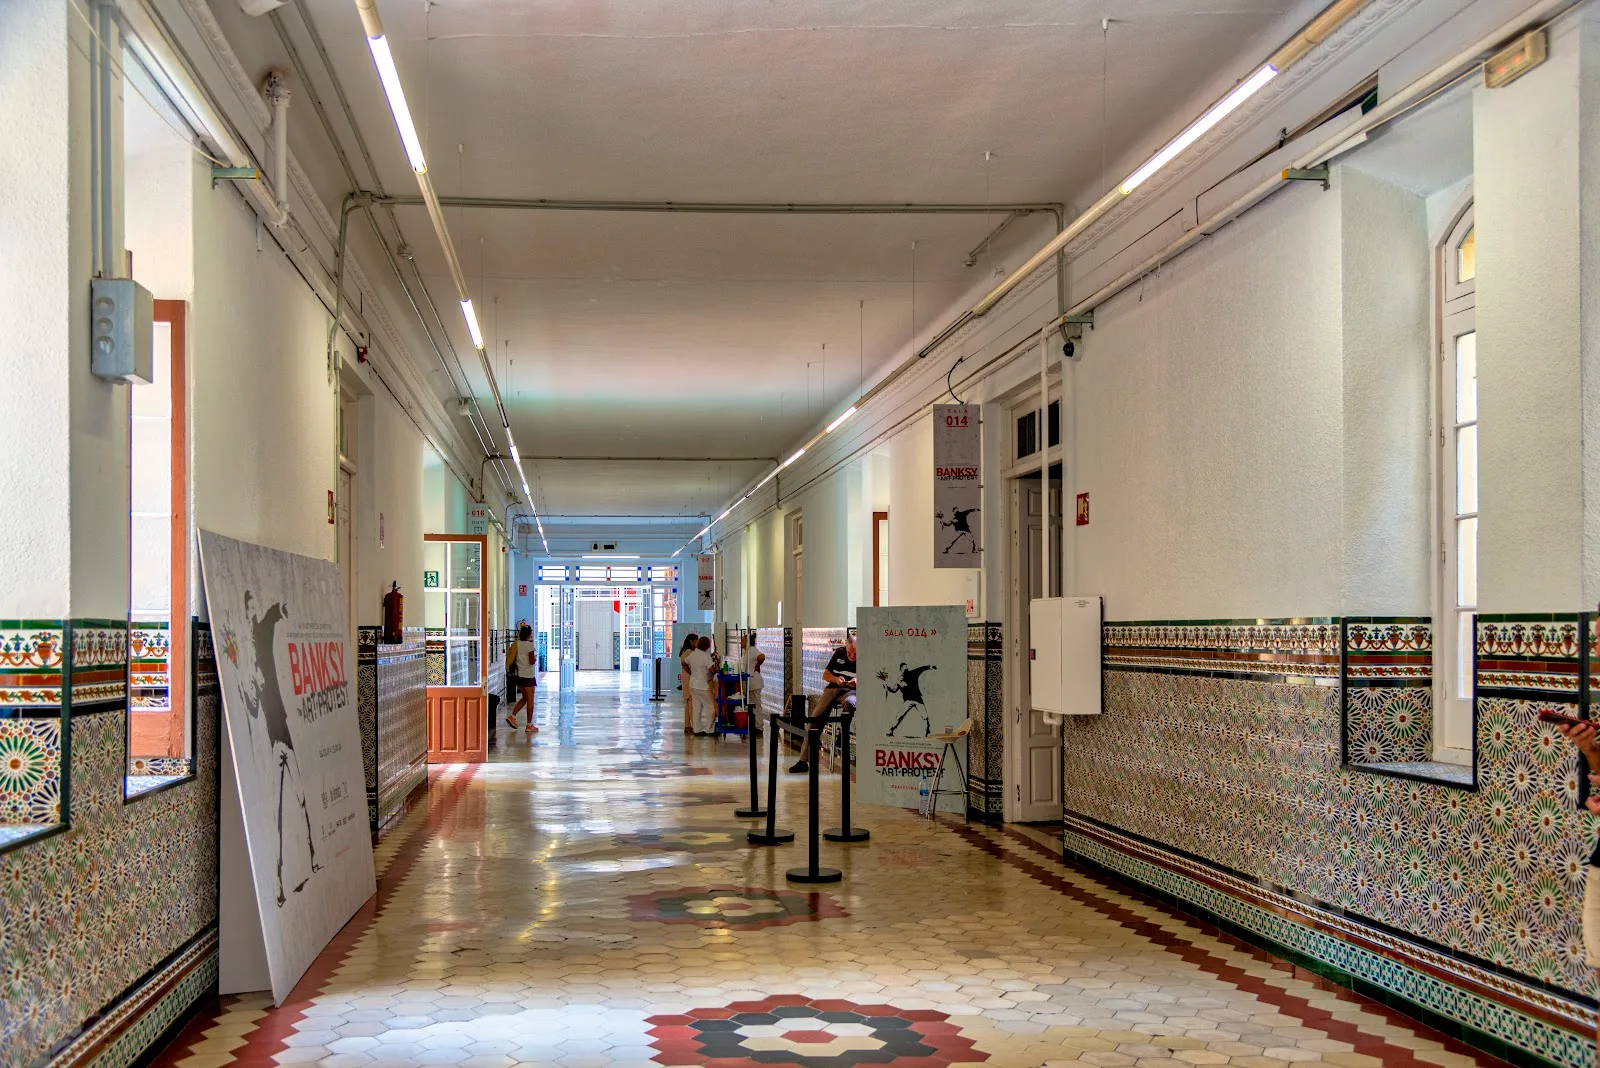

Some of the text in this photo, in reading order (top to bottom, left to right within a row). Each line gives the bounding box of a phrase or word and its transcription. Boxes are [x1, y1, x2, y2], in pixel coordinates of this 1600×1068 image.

[946, 415, 969, 426] 014
[936, 467, 978, 477] BANKSY
[471, 509, 485, 517] 016
[884, 628, 928, 638] SALA 014
[288, 641, 346, 697] BANKSY
[302, 692, 318, 724] ART
[317, 680, 350, 718] PROTEST
[881, 767, 899, 777] ART
